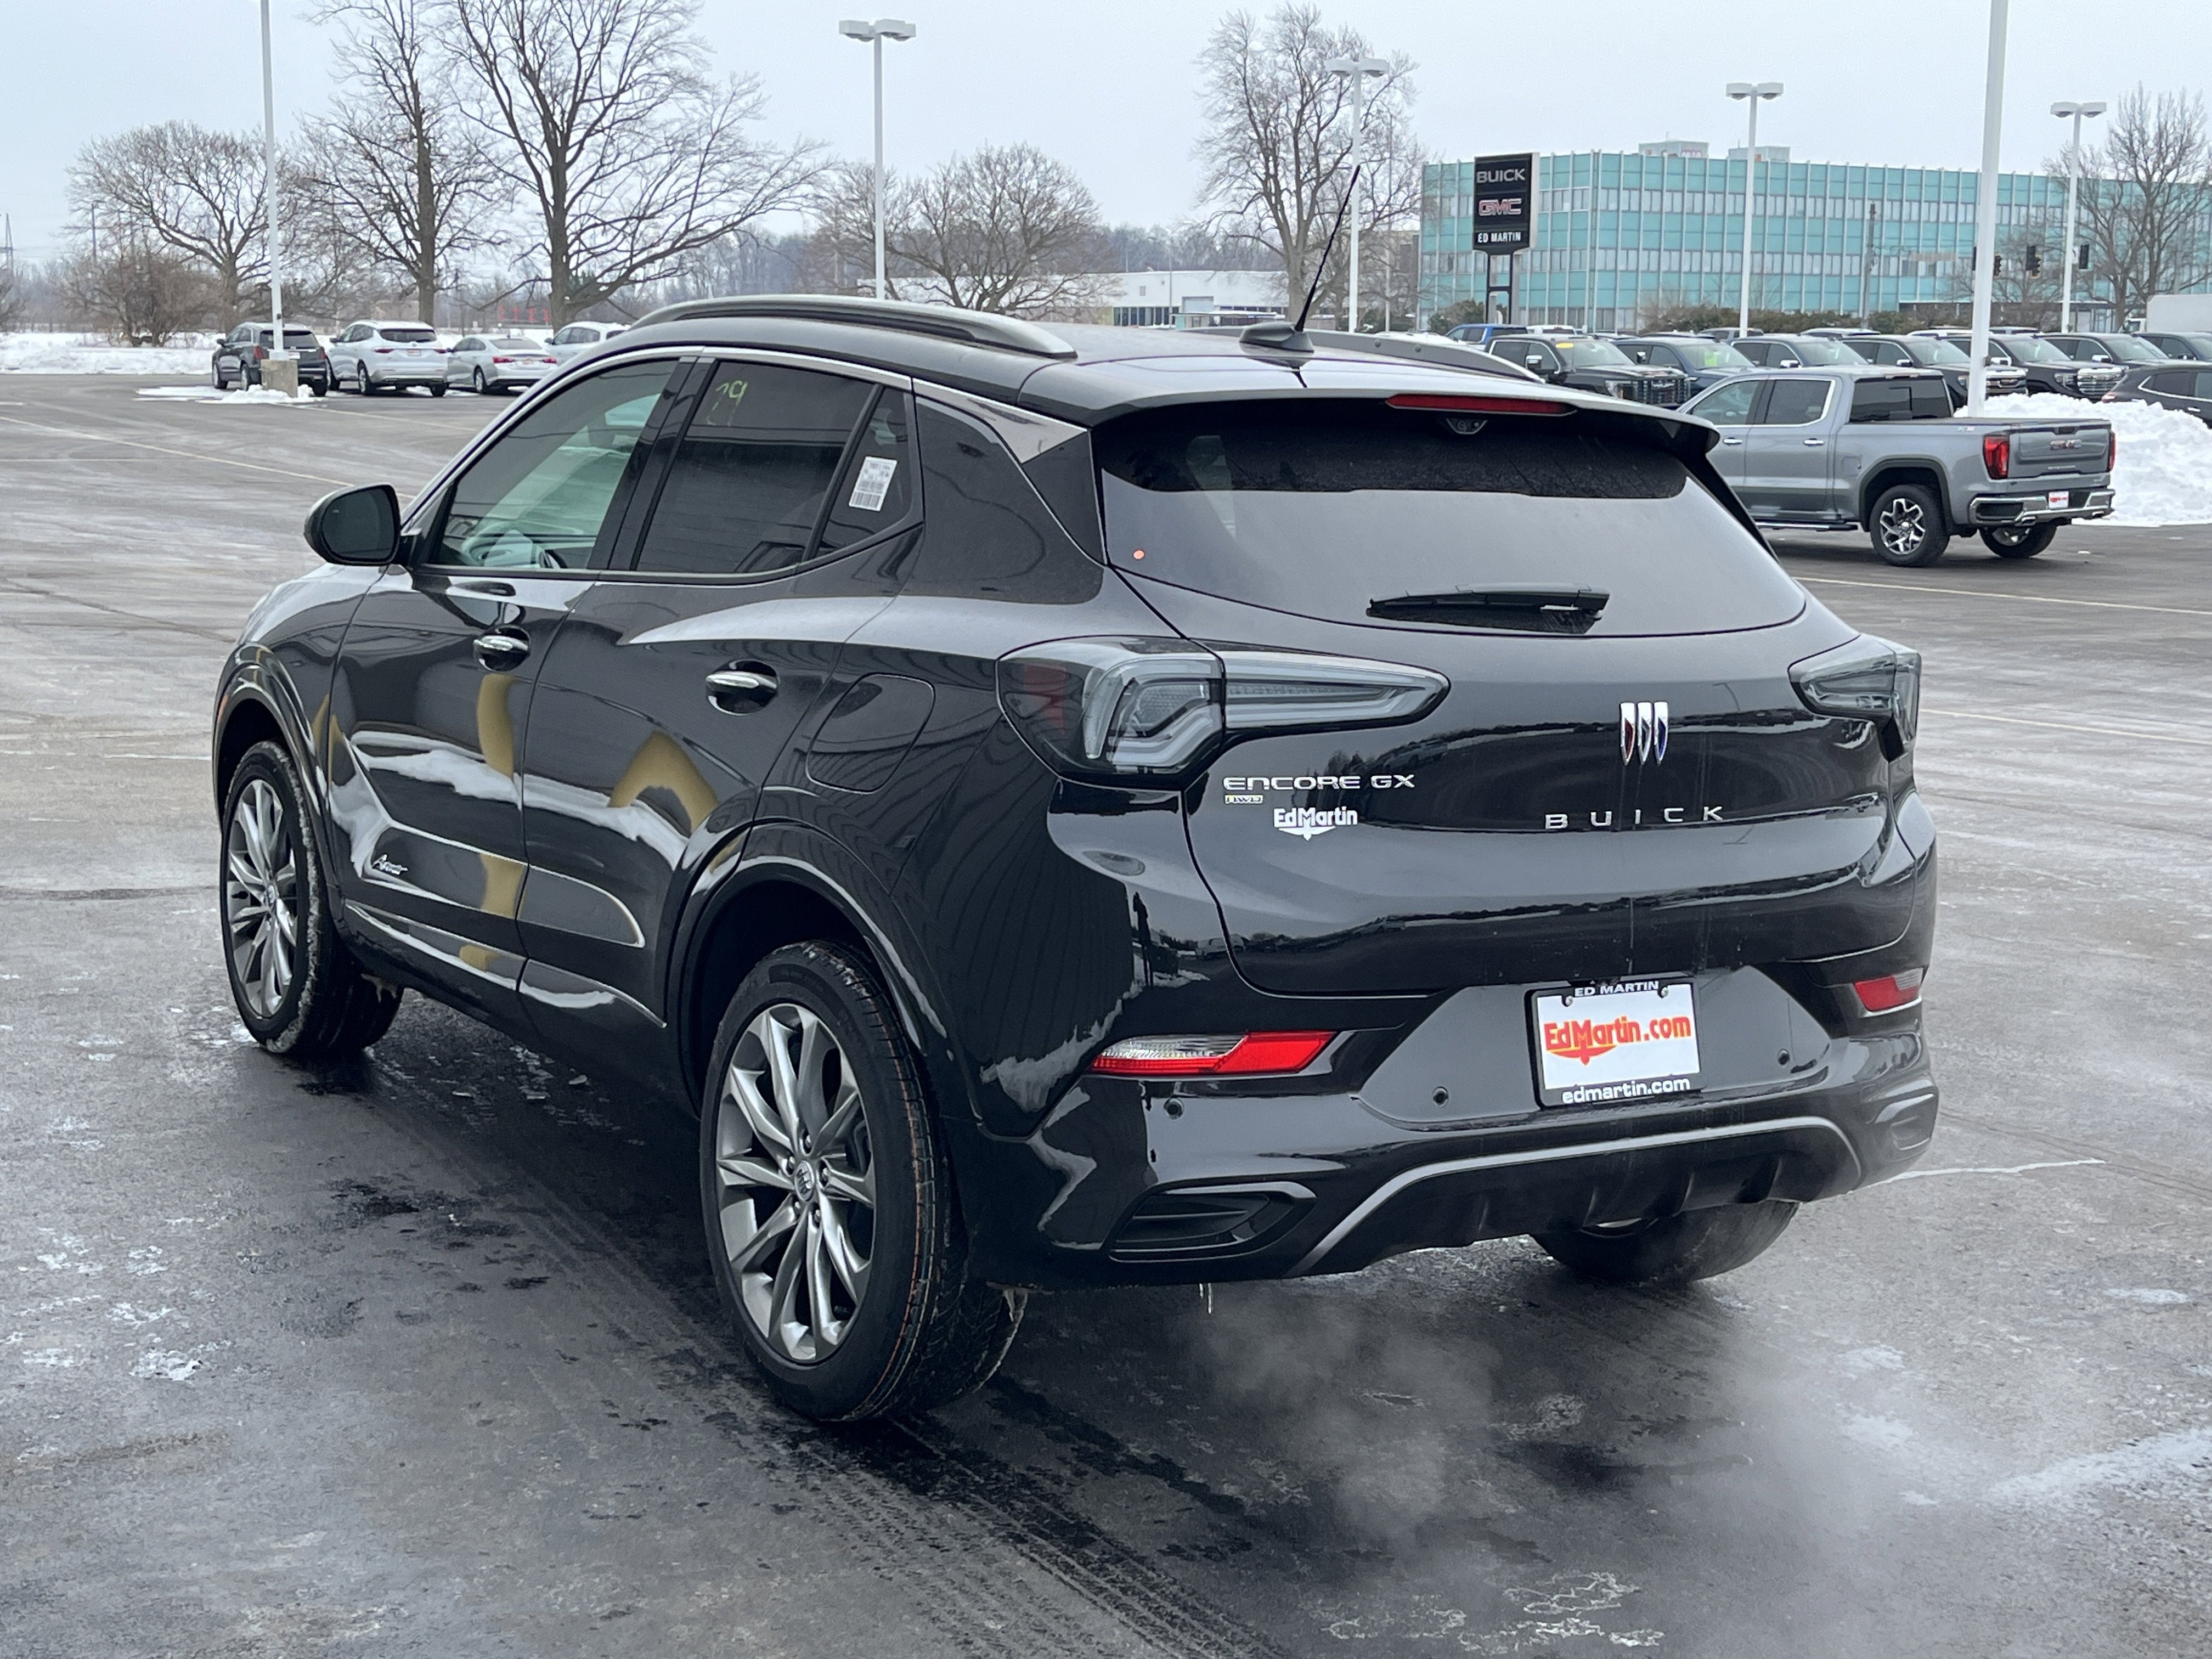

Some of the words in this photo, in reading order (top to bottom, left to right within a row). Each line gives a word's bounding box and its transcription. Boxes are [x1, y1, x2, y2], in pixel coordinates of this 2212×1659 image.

[1476, 168, 1526, 183] BUICK
[1479, 198, 1522, 216] GMC
[1477, 233, 1489, 243] ED
[1491, 232, 1522, 242] MARTIN
[1223, 775, 1361, 791] ENCORE
[1371, 774, 1415, 789] GX
[1545, 806, 1723, 830] BUICK
[1575, 986, 1596, 997] ED
[1600, 980, 1660, 995] MARTIN
[1562, 1077, 1691, 1104] edmartin.com
